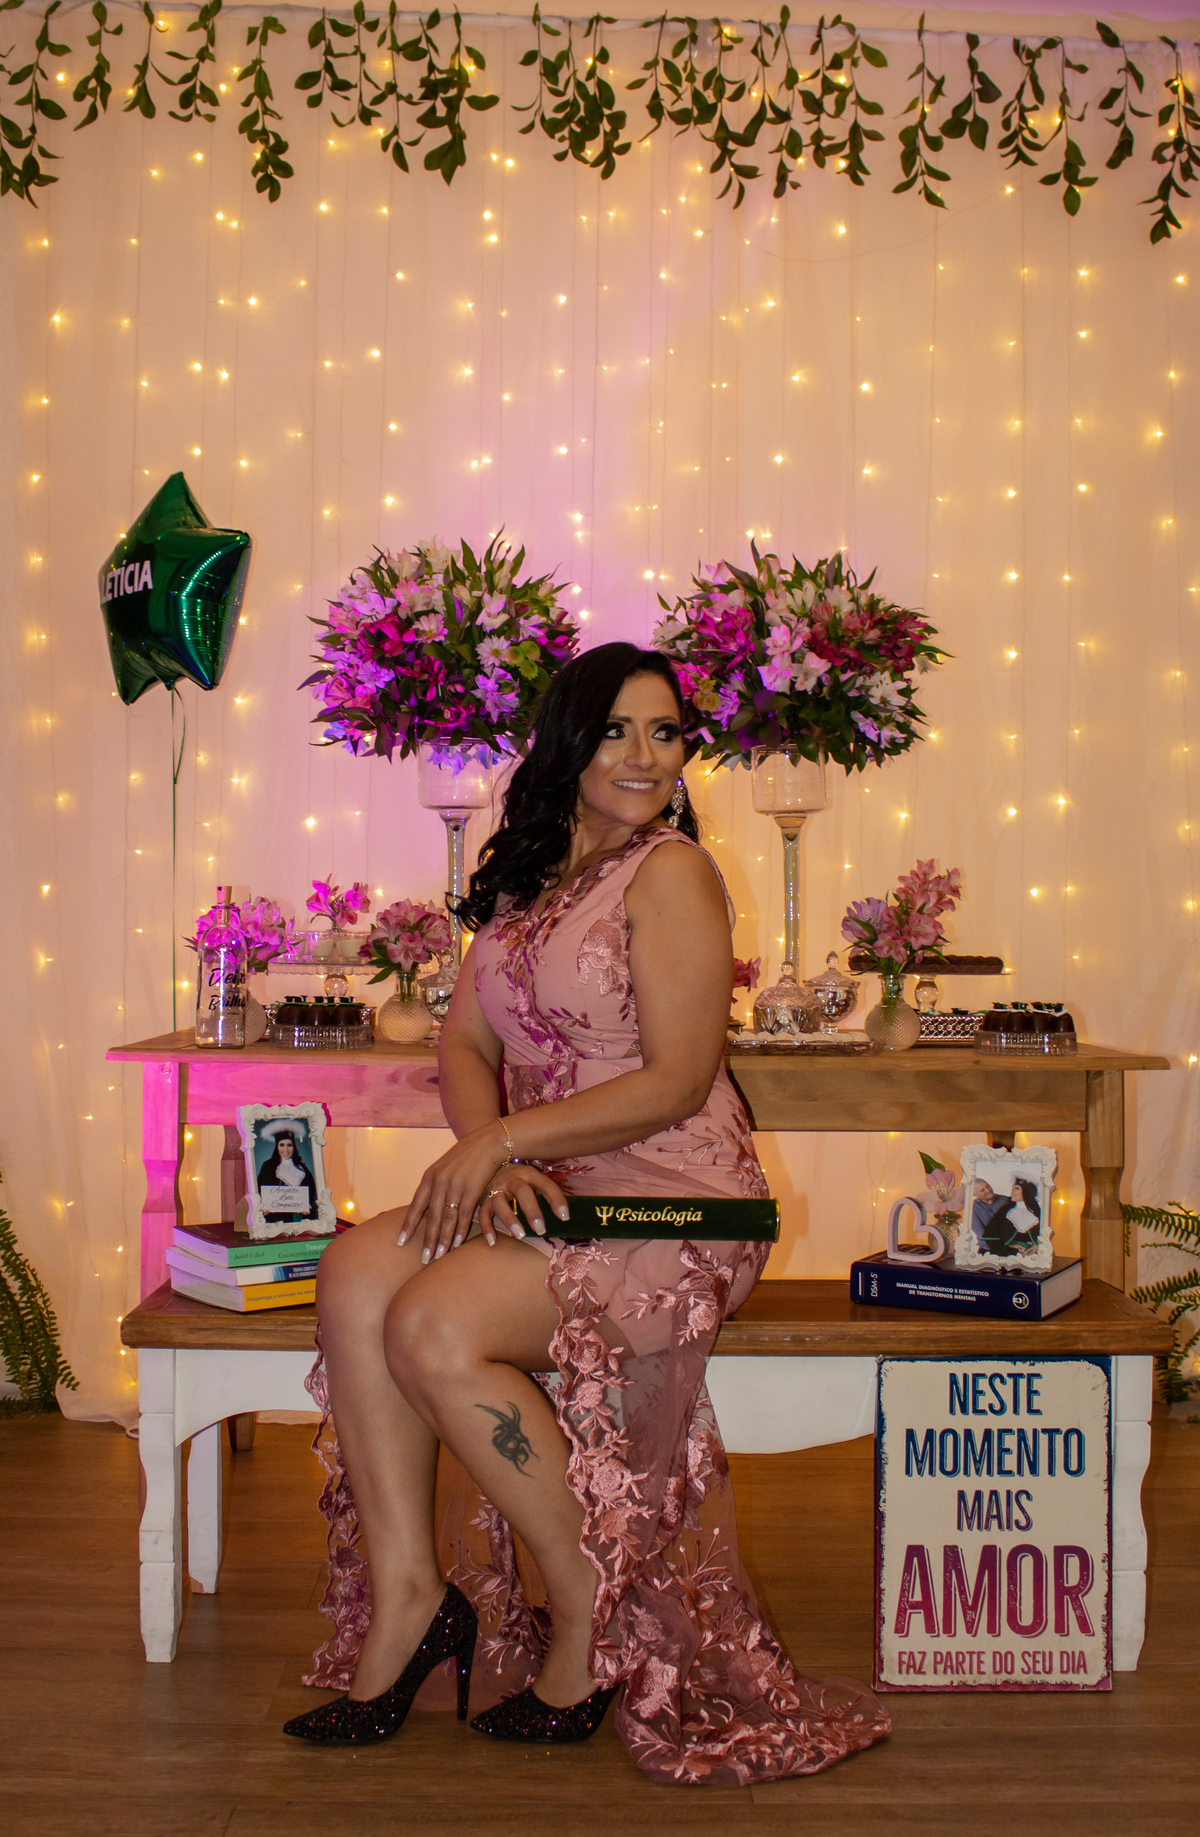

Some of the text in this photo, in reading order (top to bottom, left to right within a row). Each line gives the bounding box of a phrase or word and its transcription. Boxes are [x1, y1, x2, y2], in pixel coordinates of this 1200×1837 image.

[101, 559, 153, 605] LETÍCIA
[615, 1206, 703, 1226] Psicologia
[870, 1272, 878, 1297] DSM-5
[896, 1282, 918, 1290] MANUAL
[918, 1284, 954, 1293] DIAGNÓSTICO
[958, 1288, 990, 1297] ESTATÍSTICO
[916, 1290, 953, 1299] TRANSTORNOS
[953, 1294, 976, 1302] MENTAIS
[949, 1372, 1043, 1415] NESTE
[904, 1427, 1086, 1478] MOMENTO
[956, 1489, 1033, 1532] MAIS
[893, 1543, 1095, 1638] AMOR
[897, 1650, 1088, 1676] FAZ PARTE DO SEU DIA
